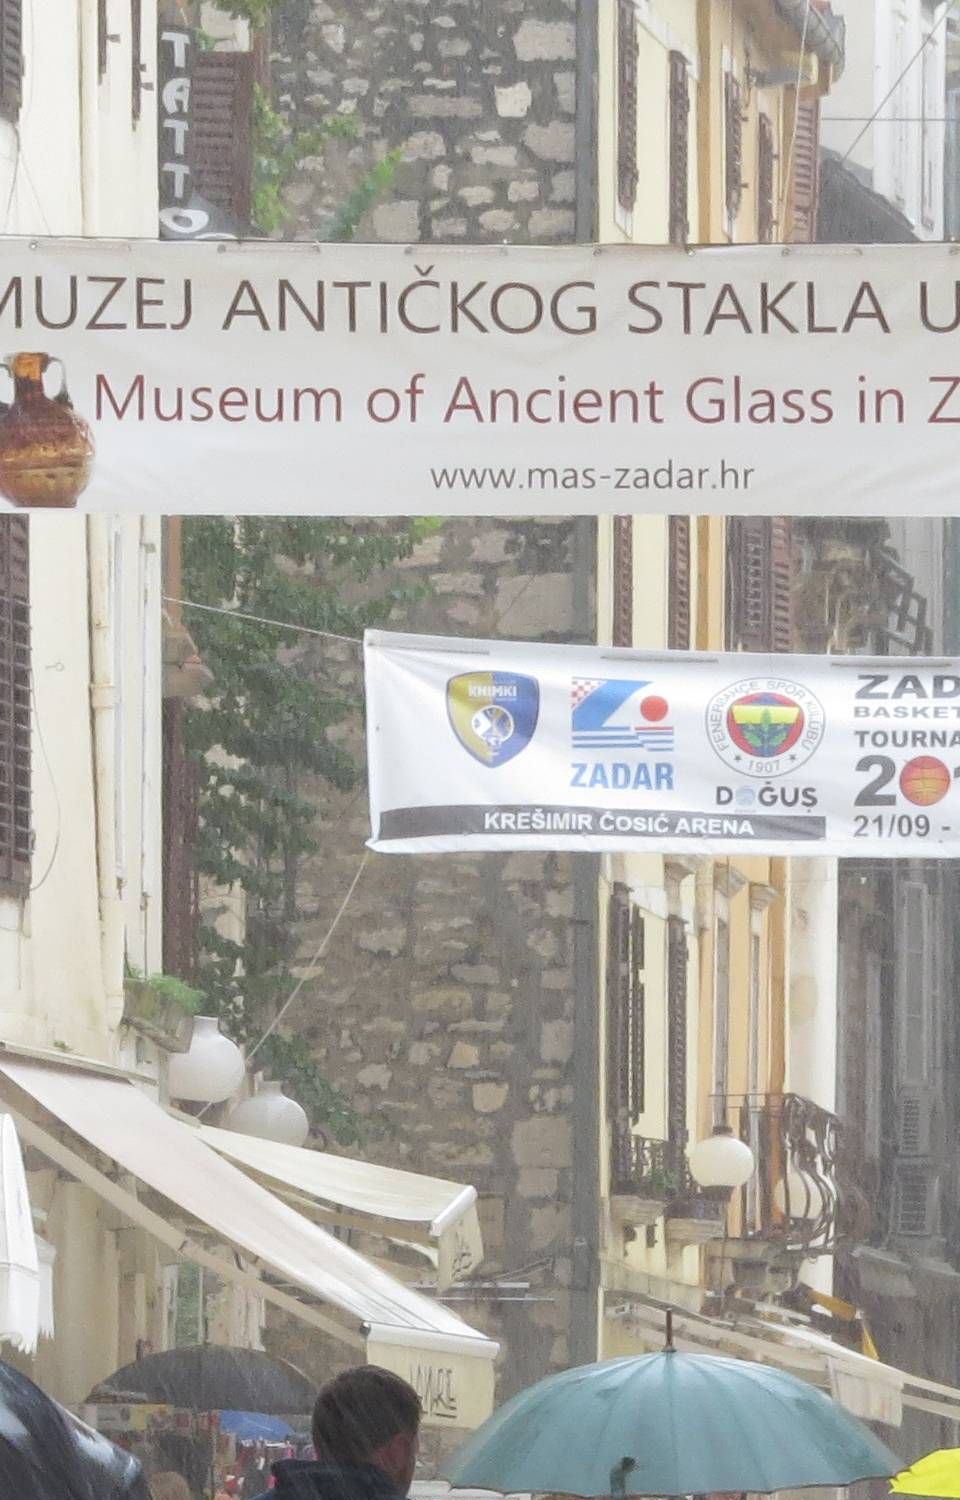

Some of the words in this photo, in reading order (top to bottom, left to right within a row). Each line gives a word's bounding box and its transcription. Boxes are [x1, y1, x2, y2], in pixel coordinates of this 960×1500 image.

[159, 31, 238, 239] TATTO
[222, 264, 598, 335] ANTIČKOG
[628, 280, 892, 335] STAKLA
[920, 281, 960, 333] U
[96, 374, 342, 422] Museum
[367, 373, 426, 423] of
[443, 375, 664, 424] Ancient
[686, 376, 834, 424] Glass
[858, 375, 905, 424] in
[927, 376, 960, 424] Z
[430, 459, 755, 489] www.mas-zadar.hr
[766, 680, 807, 701] SPOR
[854, 674, 960, 700] ZAD
[853, 730, 960, 748] TOURNA
[570, 762, 675, 791] ZADAR
[748, 759, 781, 774] 1907
[484, 808, 593, 831] KREŠIMIR
[675, 816, 755, 836] ARENA
[853, 814, 930, 838] 21/09
